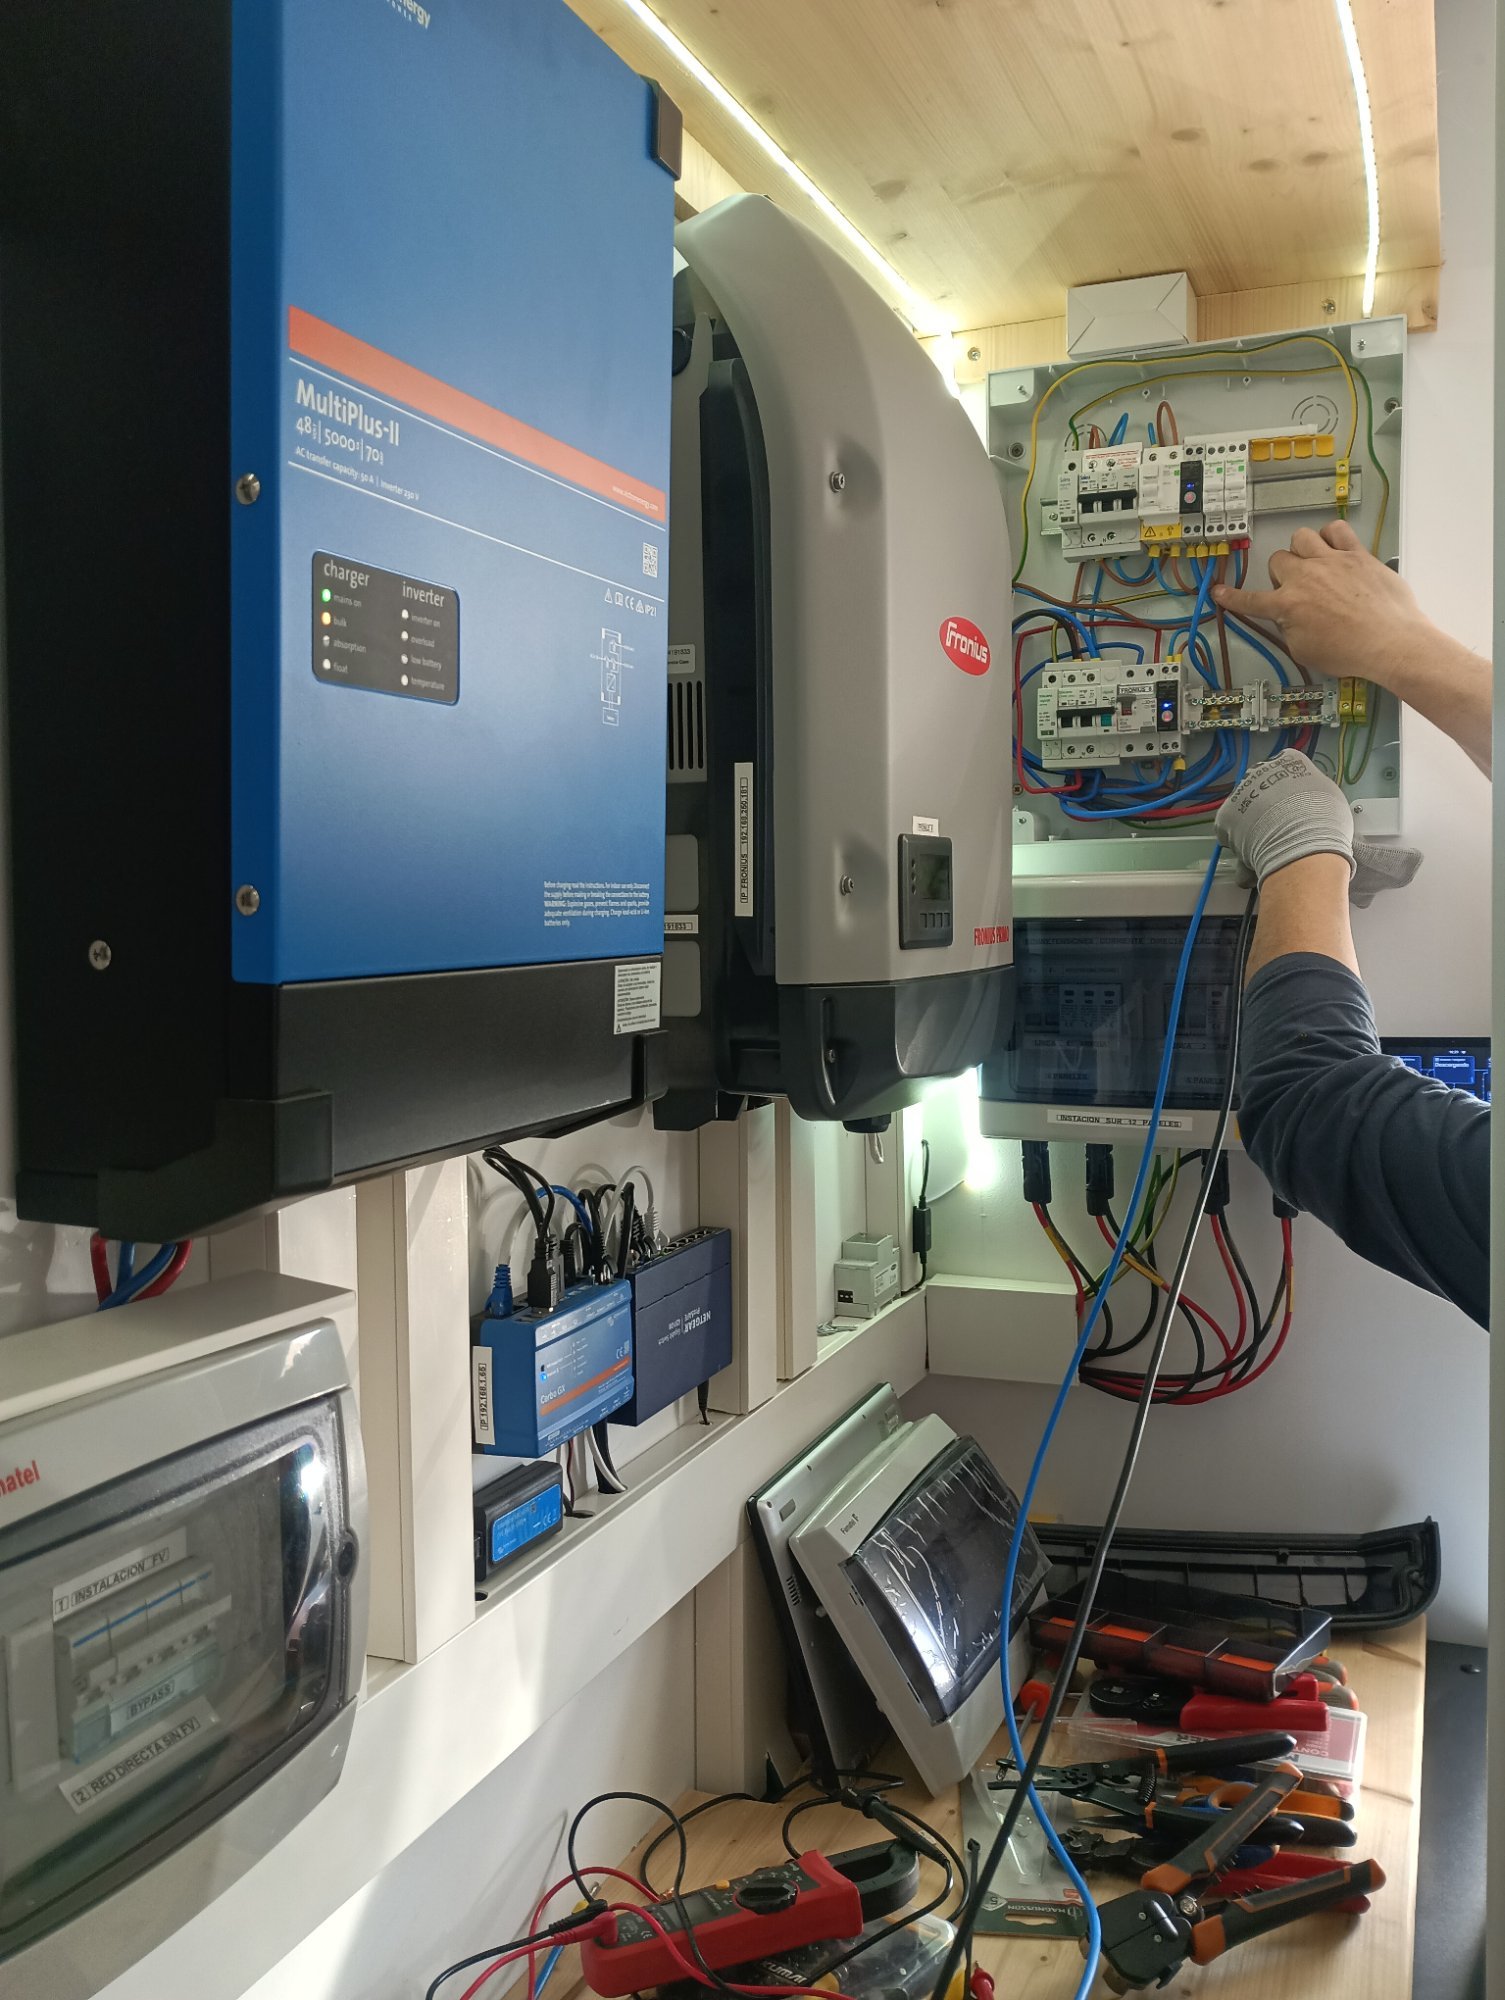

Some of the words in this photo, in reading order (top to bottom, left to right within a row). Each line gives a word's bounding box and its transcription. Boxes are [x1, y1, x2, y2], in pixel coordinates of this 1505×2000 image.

[296, 379, 399, 447] MultiPlus-II
[324, 428, 356, 451] 5000
[323, 559, 370, 589] charger
[402, 580, 445, 608] inverter
[945, 621, 988, 664] Fronius
[740, 853, 748, 889] FRONIUS
[974, 927, 995, 946] FRONIUS
[1142, 1119, 1180, 1128] PAELES
[683, 1310, 712, 1335] NETGEAR
[73, 1562, 146, 1604] INSTALACION
[151, 1550, 168, 1567] FV
[128, 1683, 172, 1718] BYPASS
[75, 1789, 88, 1806] 2
[90, 1772, 118, 1793] RED
[117, 1741, 164, 1777] DIRECTA
[162, 1730, 182, 1750] SIN
[181, 1719, 199, 1738] FV
[1008, 1905, 1066, 1914] MAGNUSSON
